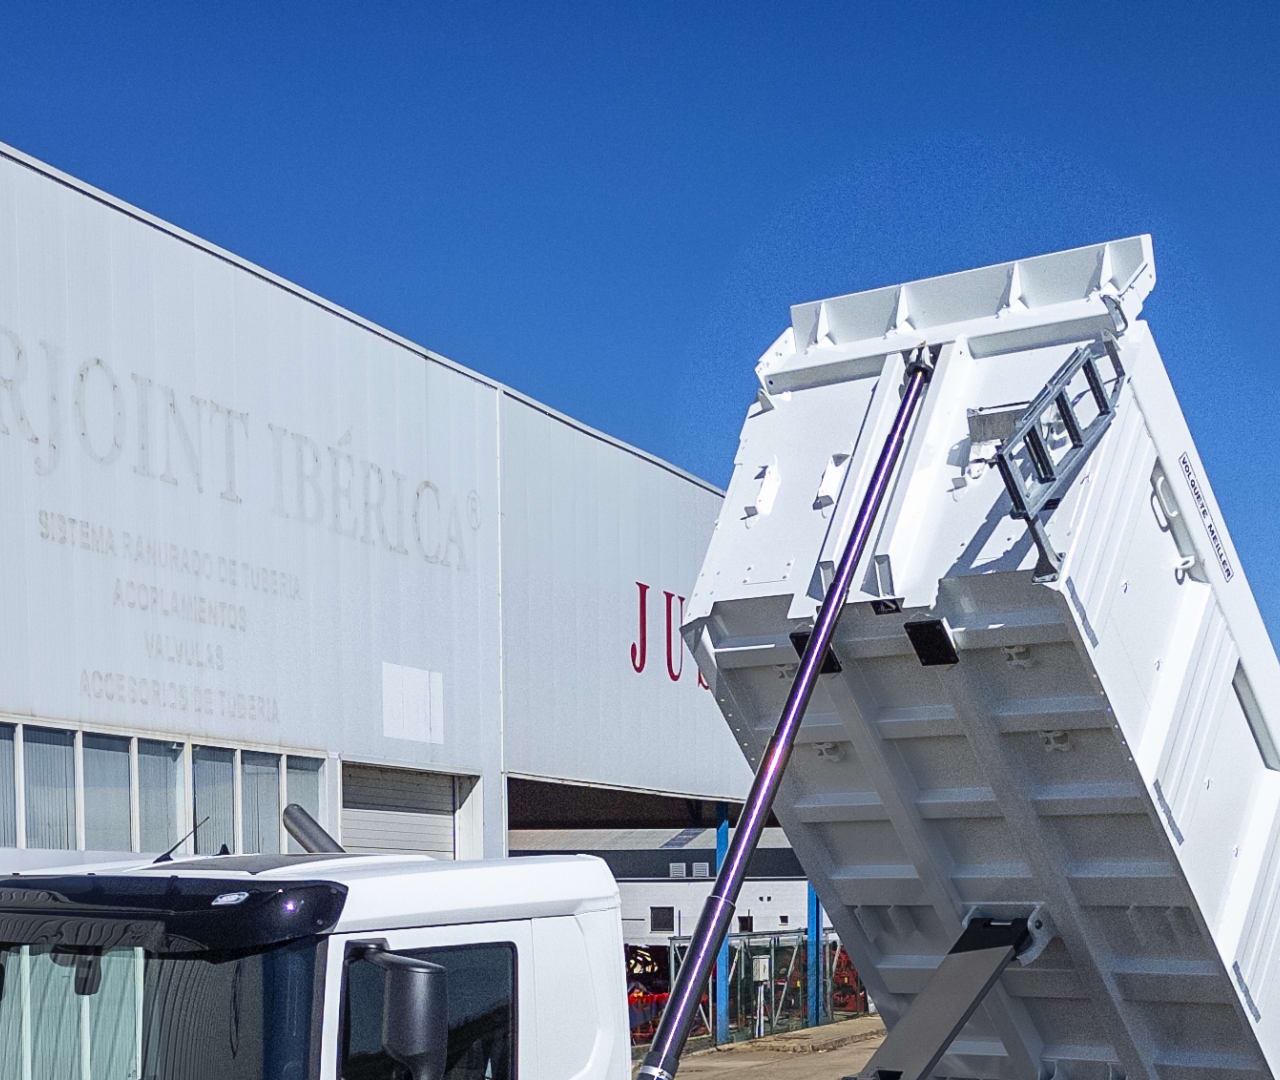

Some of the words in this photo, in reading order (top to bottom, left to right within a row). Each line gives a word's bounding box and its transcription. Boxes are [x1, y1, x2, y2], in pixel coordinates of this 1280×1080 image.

[38, 509, 117, 557] SISTEMA
[217, 554, 238, 588] DE
[1181, 456, 1208, 519] VOLQUETE
[1207, 523, 1231, 578] MEILLER
[112, 576, 247, 633] ACOPLAMIENTOS
[631, 581, 710, 690] JU
[80, 668, 188, 711] ACCESORIOS
[192, 686, 215, 716] DE
